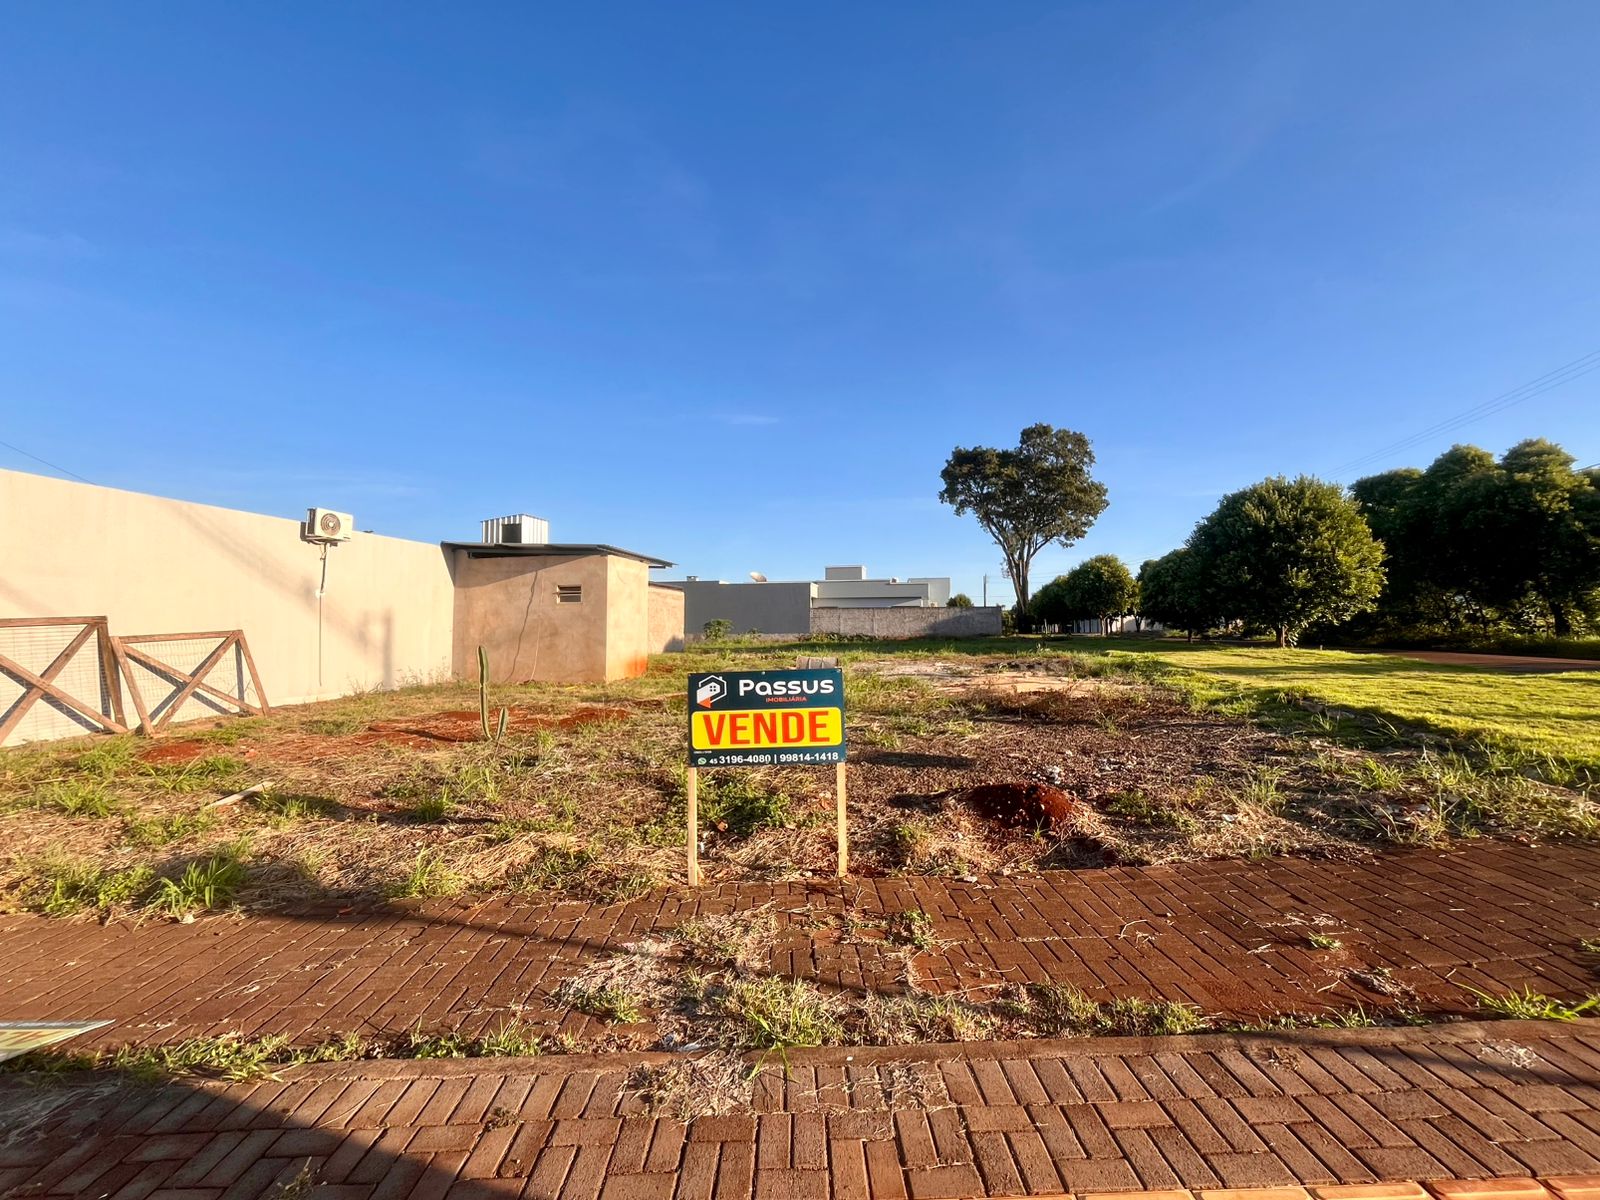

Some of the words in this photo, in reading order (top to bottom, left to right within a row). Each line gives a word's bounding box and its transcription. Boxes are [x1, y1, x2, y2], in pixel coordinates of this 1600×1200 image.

[739, 679, 834, 696] Passus
[702, 711, 830, 745] VENDE
[719, 754, 771, 764] 3196-4080
[779, 752, 839, 763] 99814-1418
